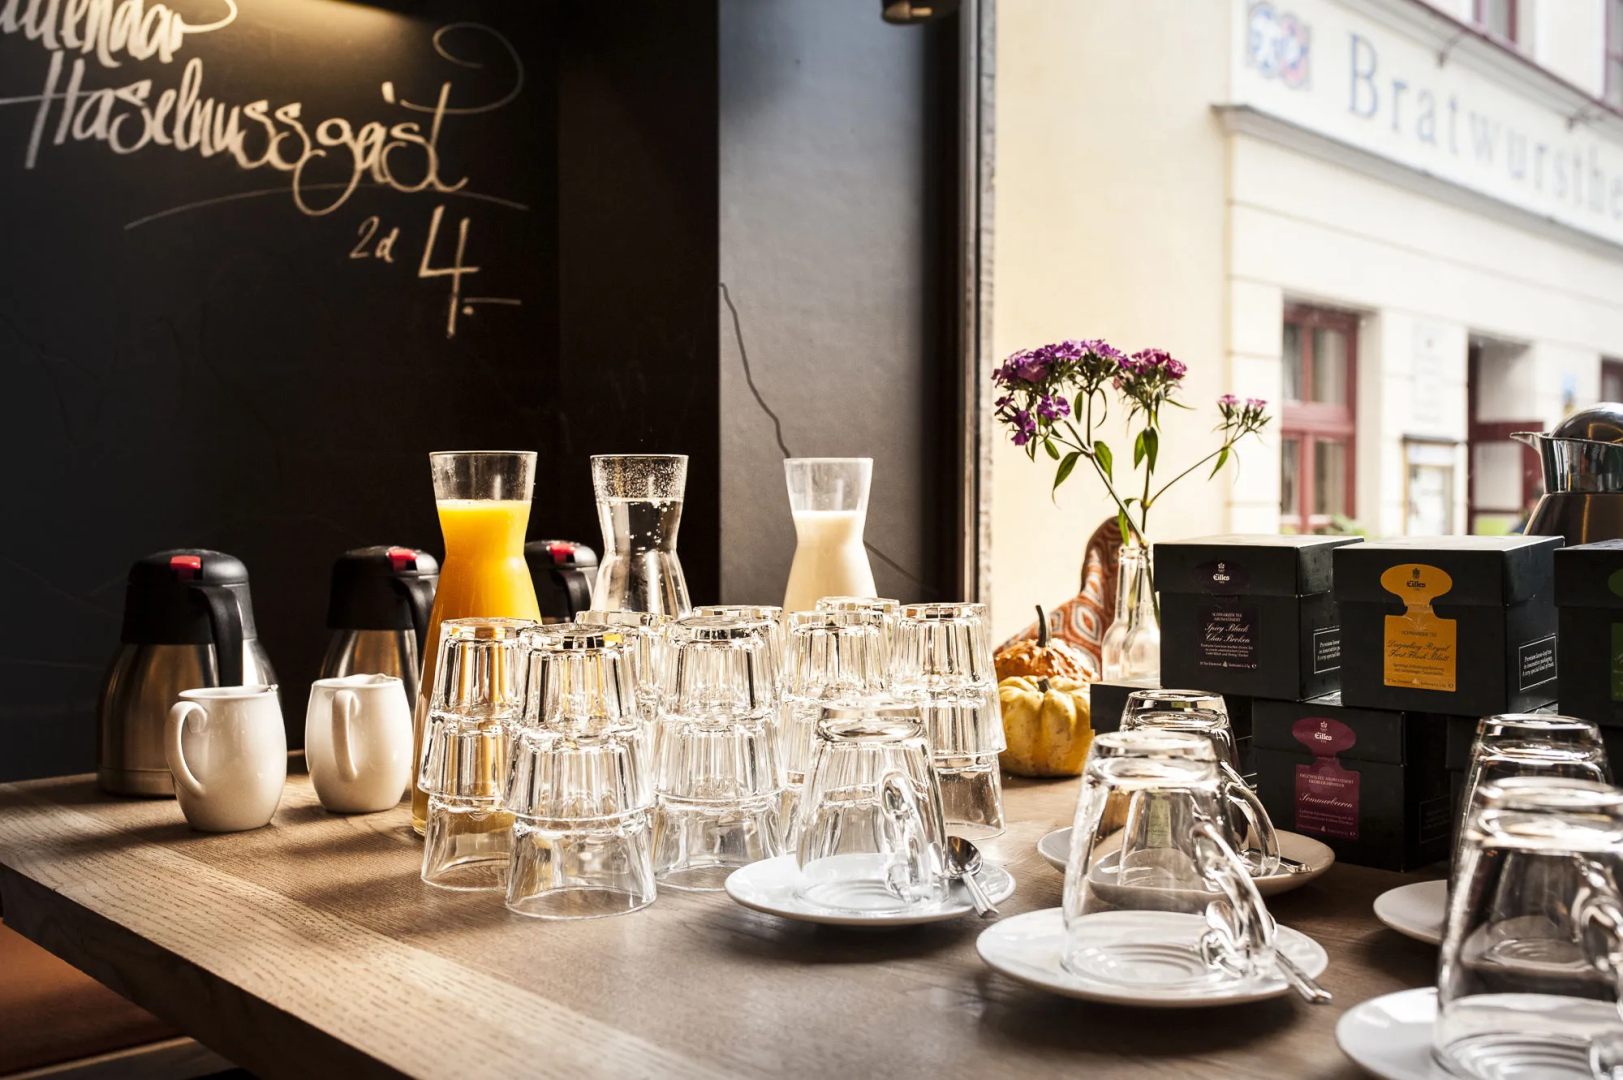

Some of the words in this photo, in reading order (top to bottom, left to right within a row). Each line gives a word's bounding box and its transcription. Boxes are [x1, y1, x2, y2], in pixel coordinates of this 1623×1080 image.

[1204, 622, 1225, 633] Spicy
[1226, 623, 1249, 632] Black
[1299, 792, 1353, 808] Sommerbeeren
